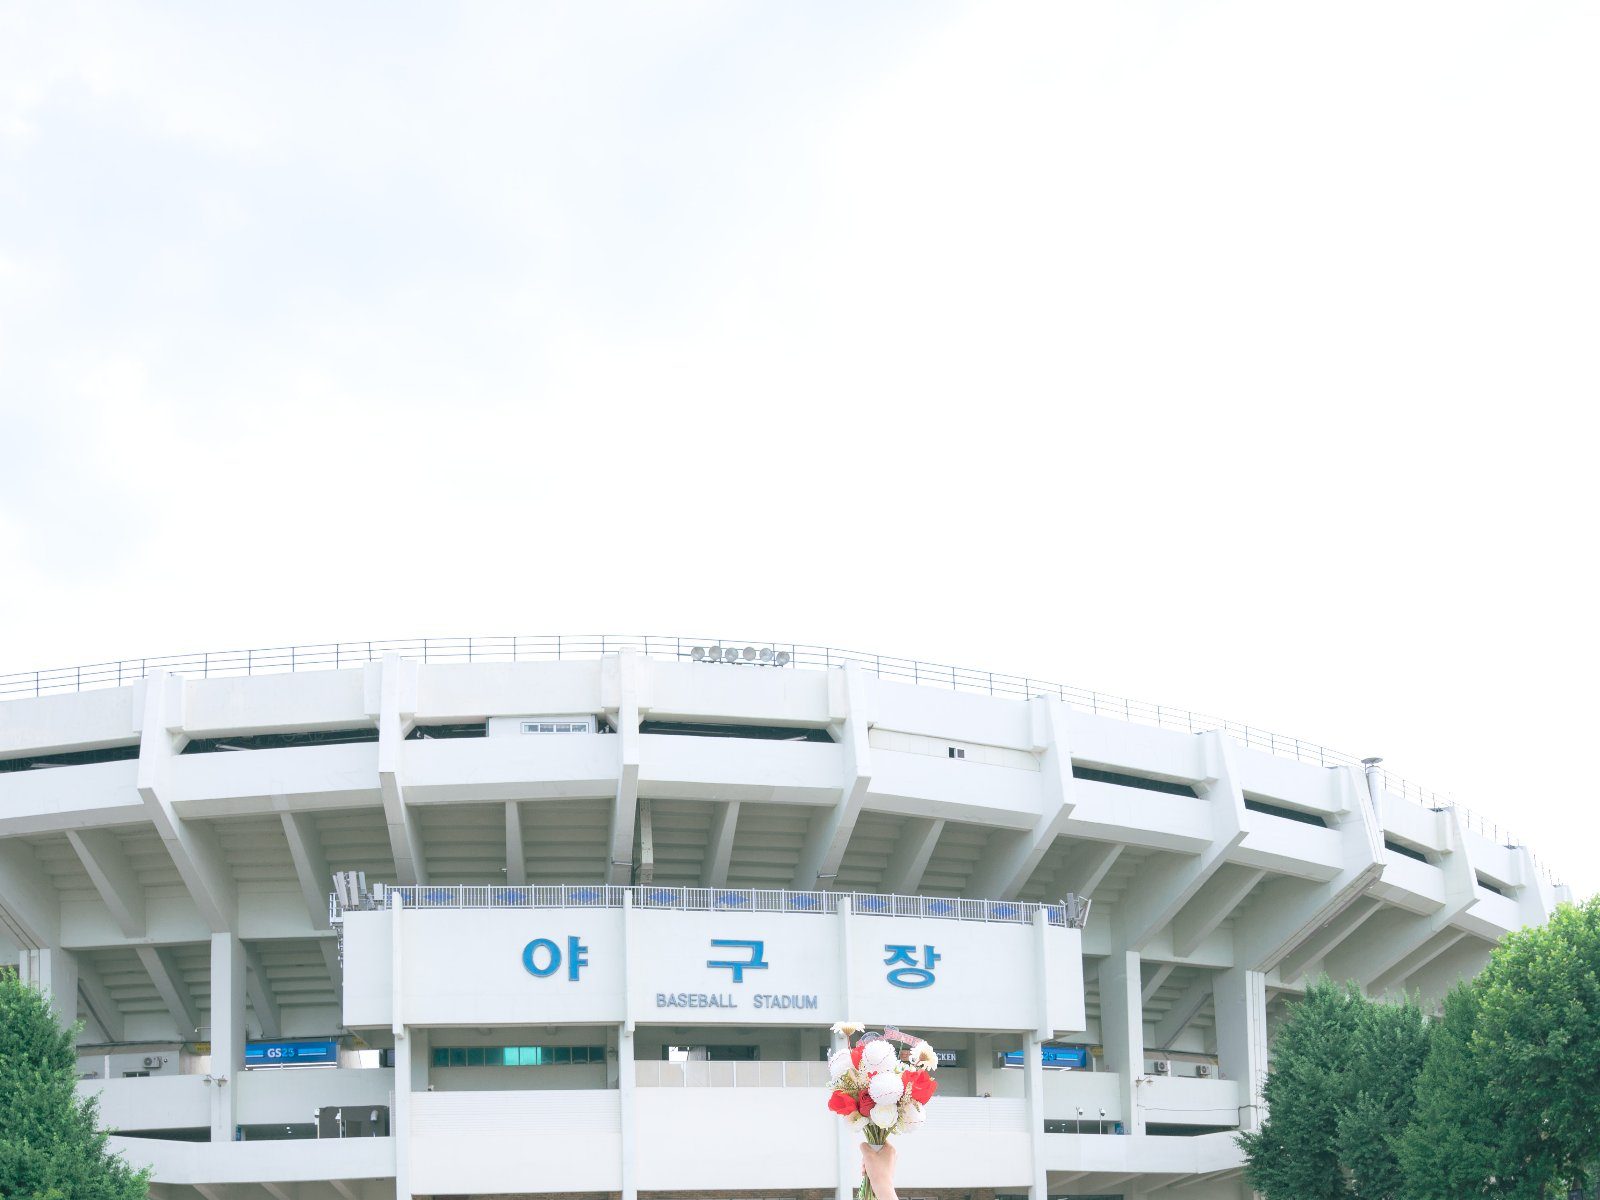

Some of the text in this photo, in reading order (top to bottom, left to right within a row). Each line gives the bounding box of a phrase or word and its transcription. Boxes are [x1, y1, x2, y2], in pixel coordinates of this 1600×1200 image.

[656, 992, 818, 1010] BASEBALL STADIUM
[267, 1048, 295, 1058] GS25
[936, 1052, 956, 1061] CKEN
